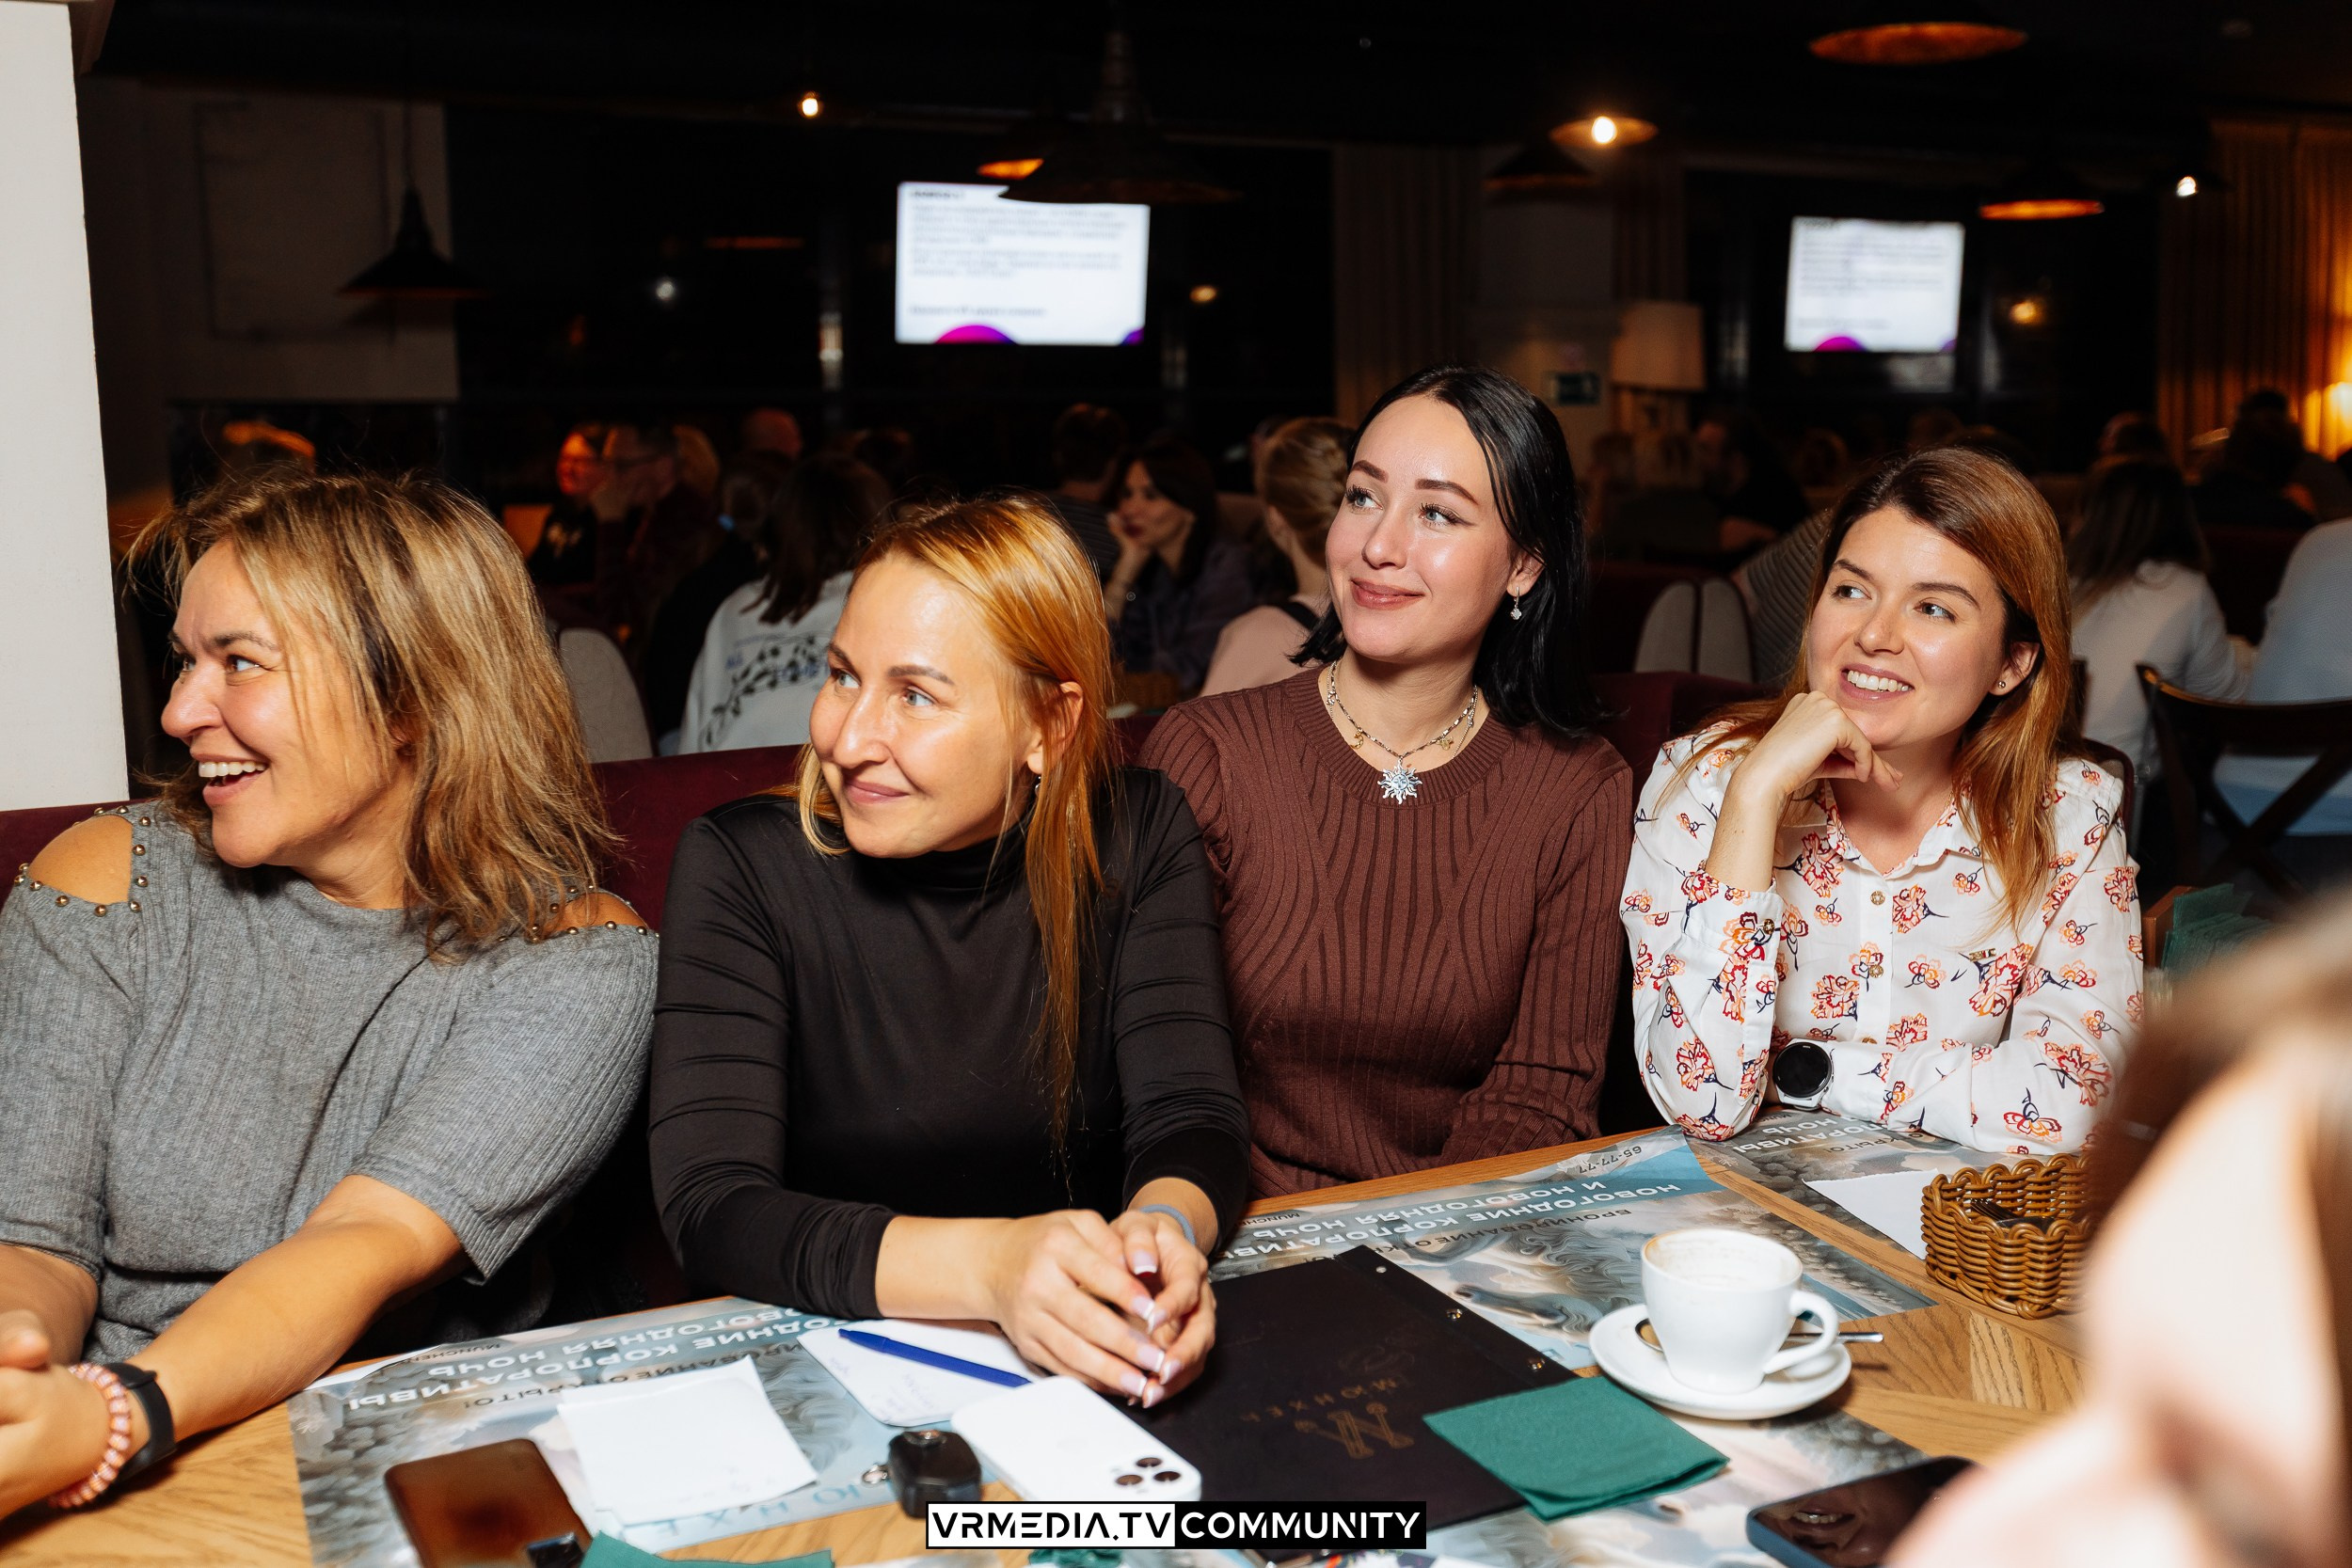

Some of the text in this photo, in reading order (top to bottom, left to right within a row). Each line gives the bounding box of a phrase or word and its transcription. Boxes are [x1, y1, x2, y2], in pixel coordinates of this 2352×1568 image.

[1762, 1117, 1838, 1135] НОЧЬ
[1579, 1146, 1643, 1174] 65-77-77
[1252, 1181, 1607, 1239] И НОВОГОДНЯЯ НОЧЬ
[1466, 1184, 1682, 1222] НОВОГОДНИЕ
[1435, 1209, 1632, 1245] БРОНИРОВАНИЕ
[347, 1343, 678, 1410] КОРПОРАТИВЫ
[427, 1350, 546, 1377] НОЧЬ
